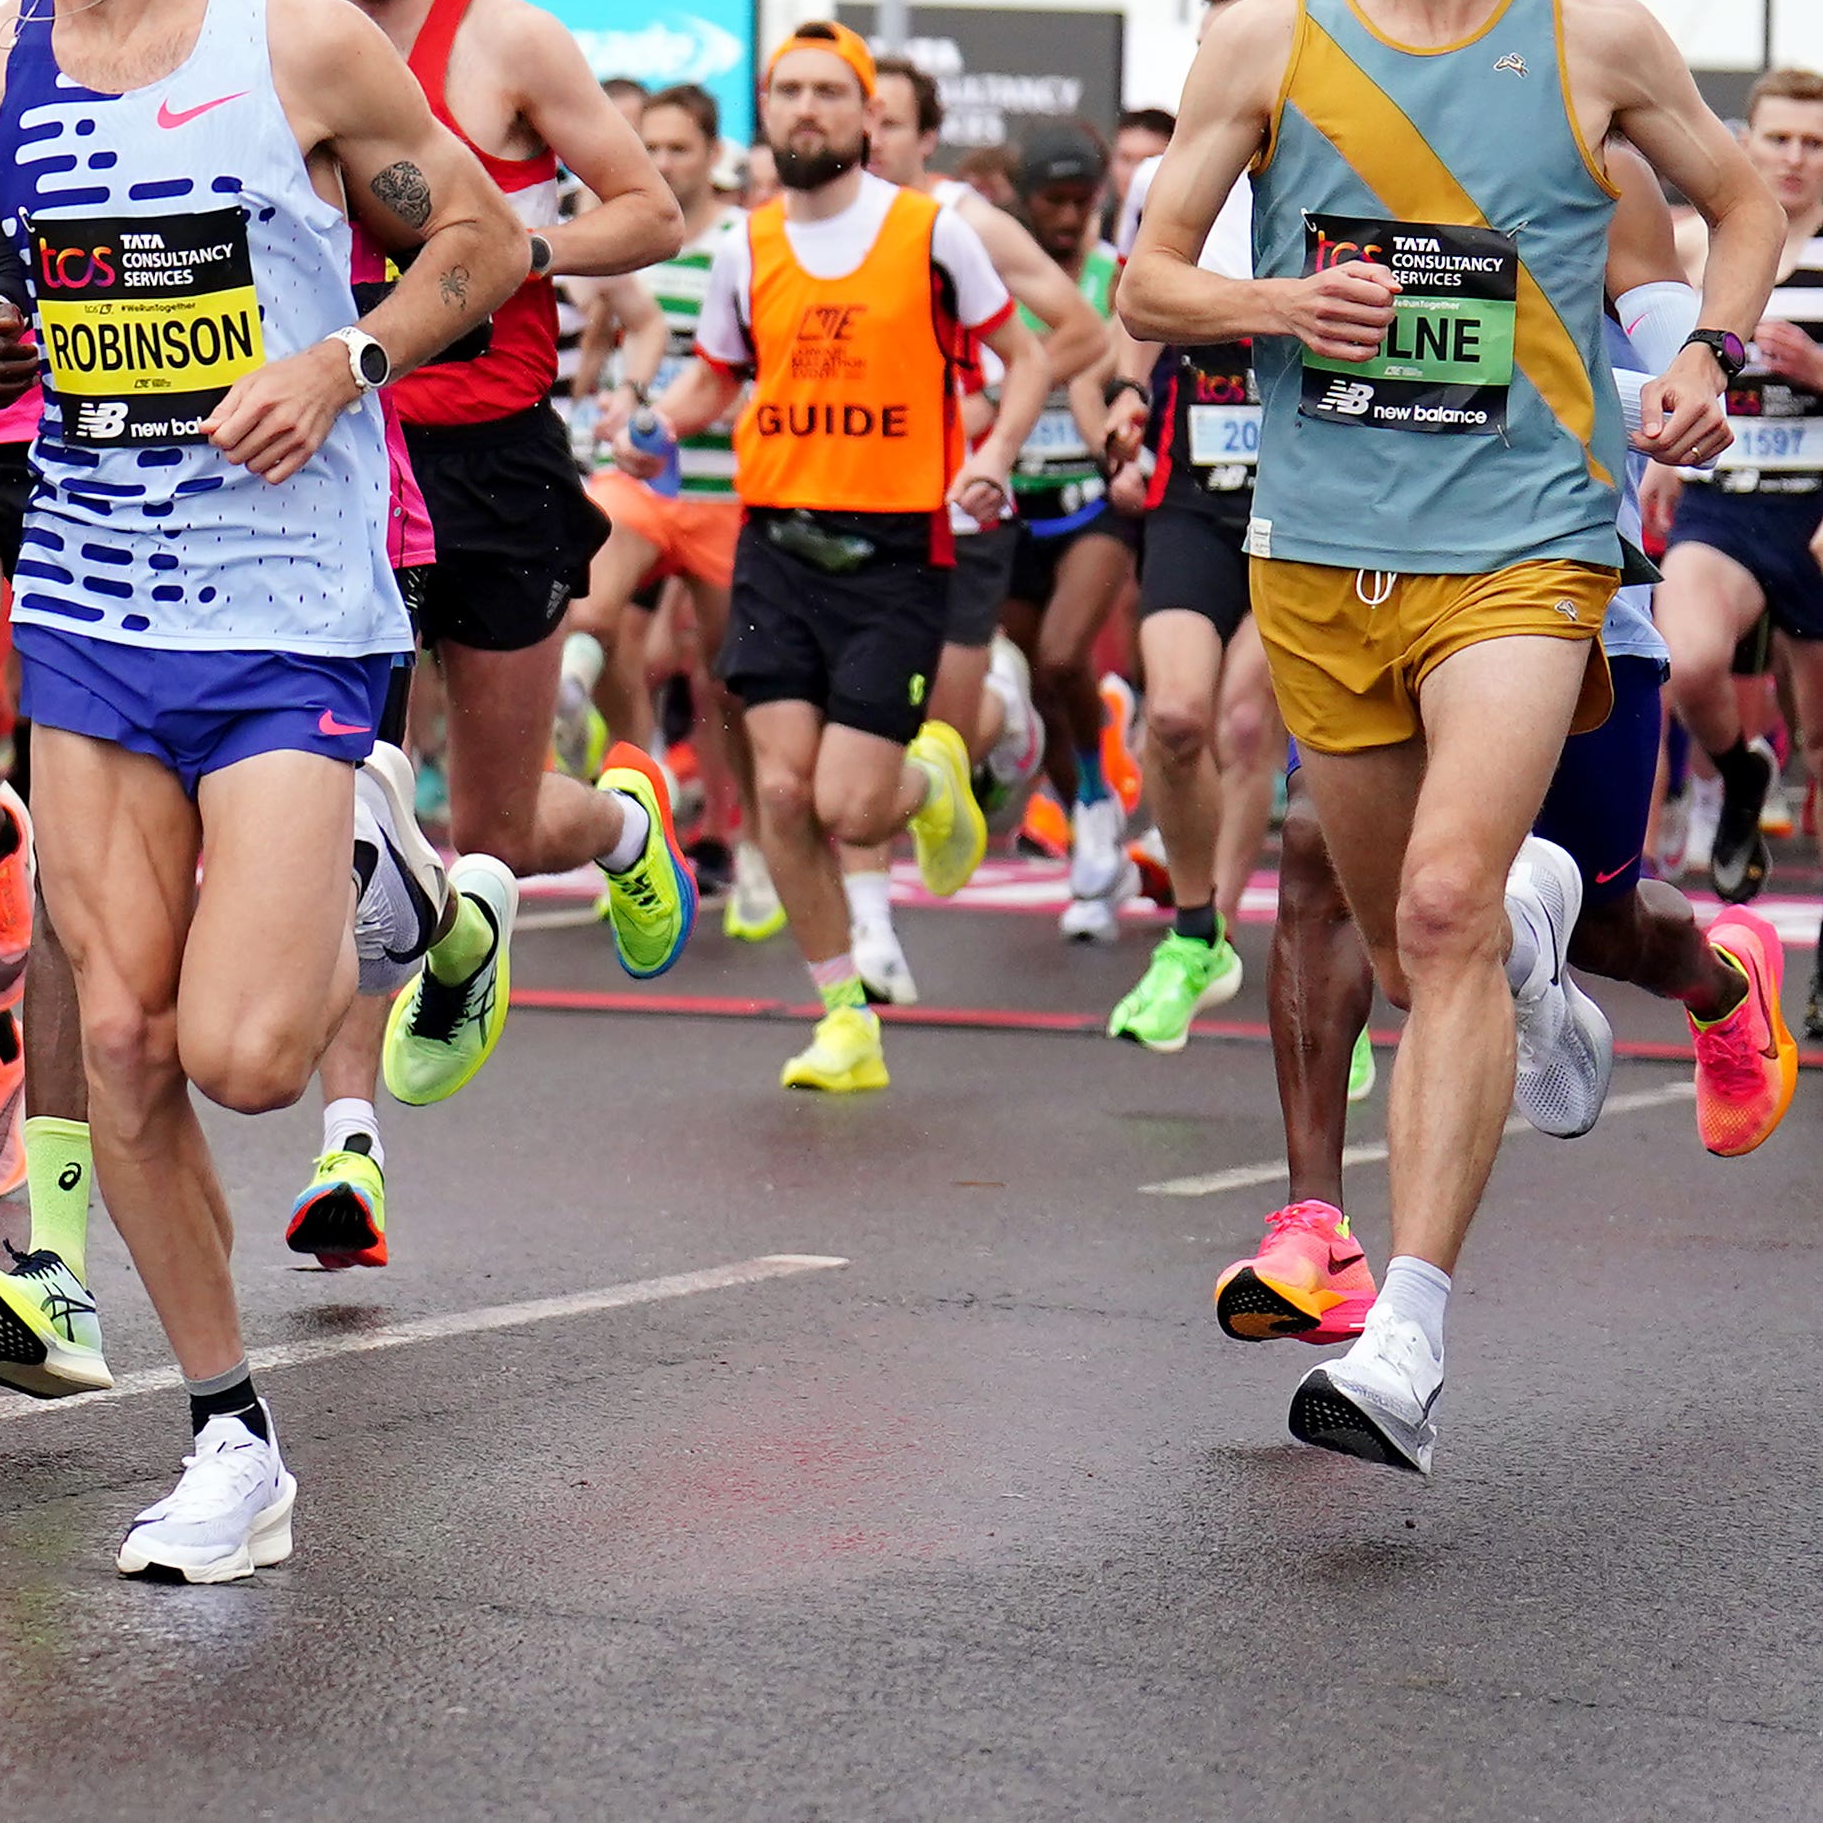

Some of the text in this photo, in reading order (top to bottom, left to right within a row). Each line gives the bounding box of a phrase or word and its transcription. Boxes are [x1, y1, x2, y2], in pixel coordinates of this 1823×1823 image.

[122, 242, 233, 268] CONSULTANCY
[1392, 236, 1441, 253] TATA
[40, 233, 165, 289] tcs TATA
[1391, 253, 1504, 273] CONSULTANCY
[124, 269, 194, 288] SERVICES
[1392, 270, 1462, 287] SERVICES
[51, 310, 254, 372] ROBINSON
[1385, 315, 1481, 363] LNE
[757, 403, 909, 438] GUIDE
[1374, 404, 1488, 425] new balance
[130, 423, 168, 438] new
